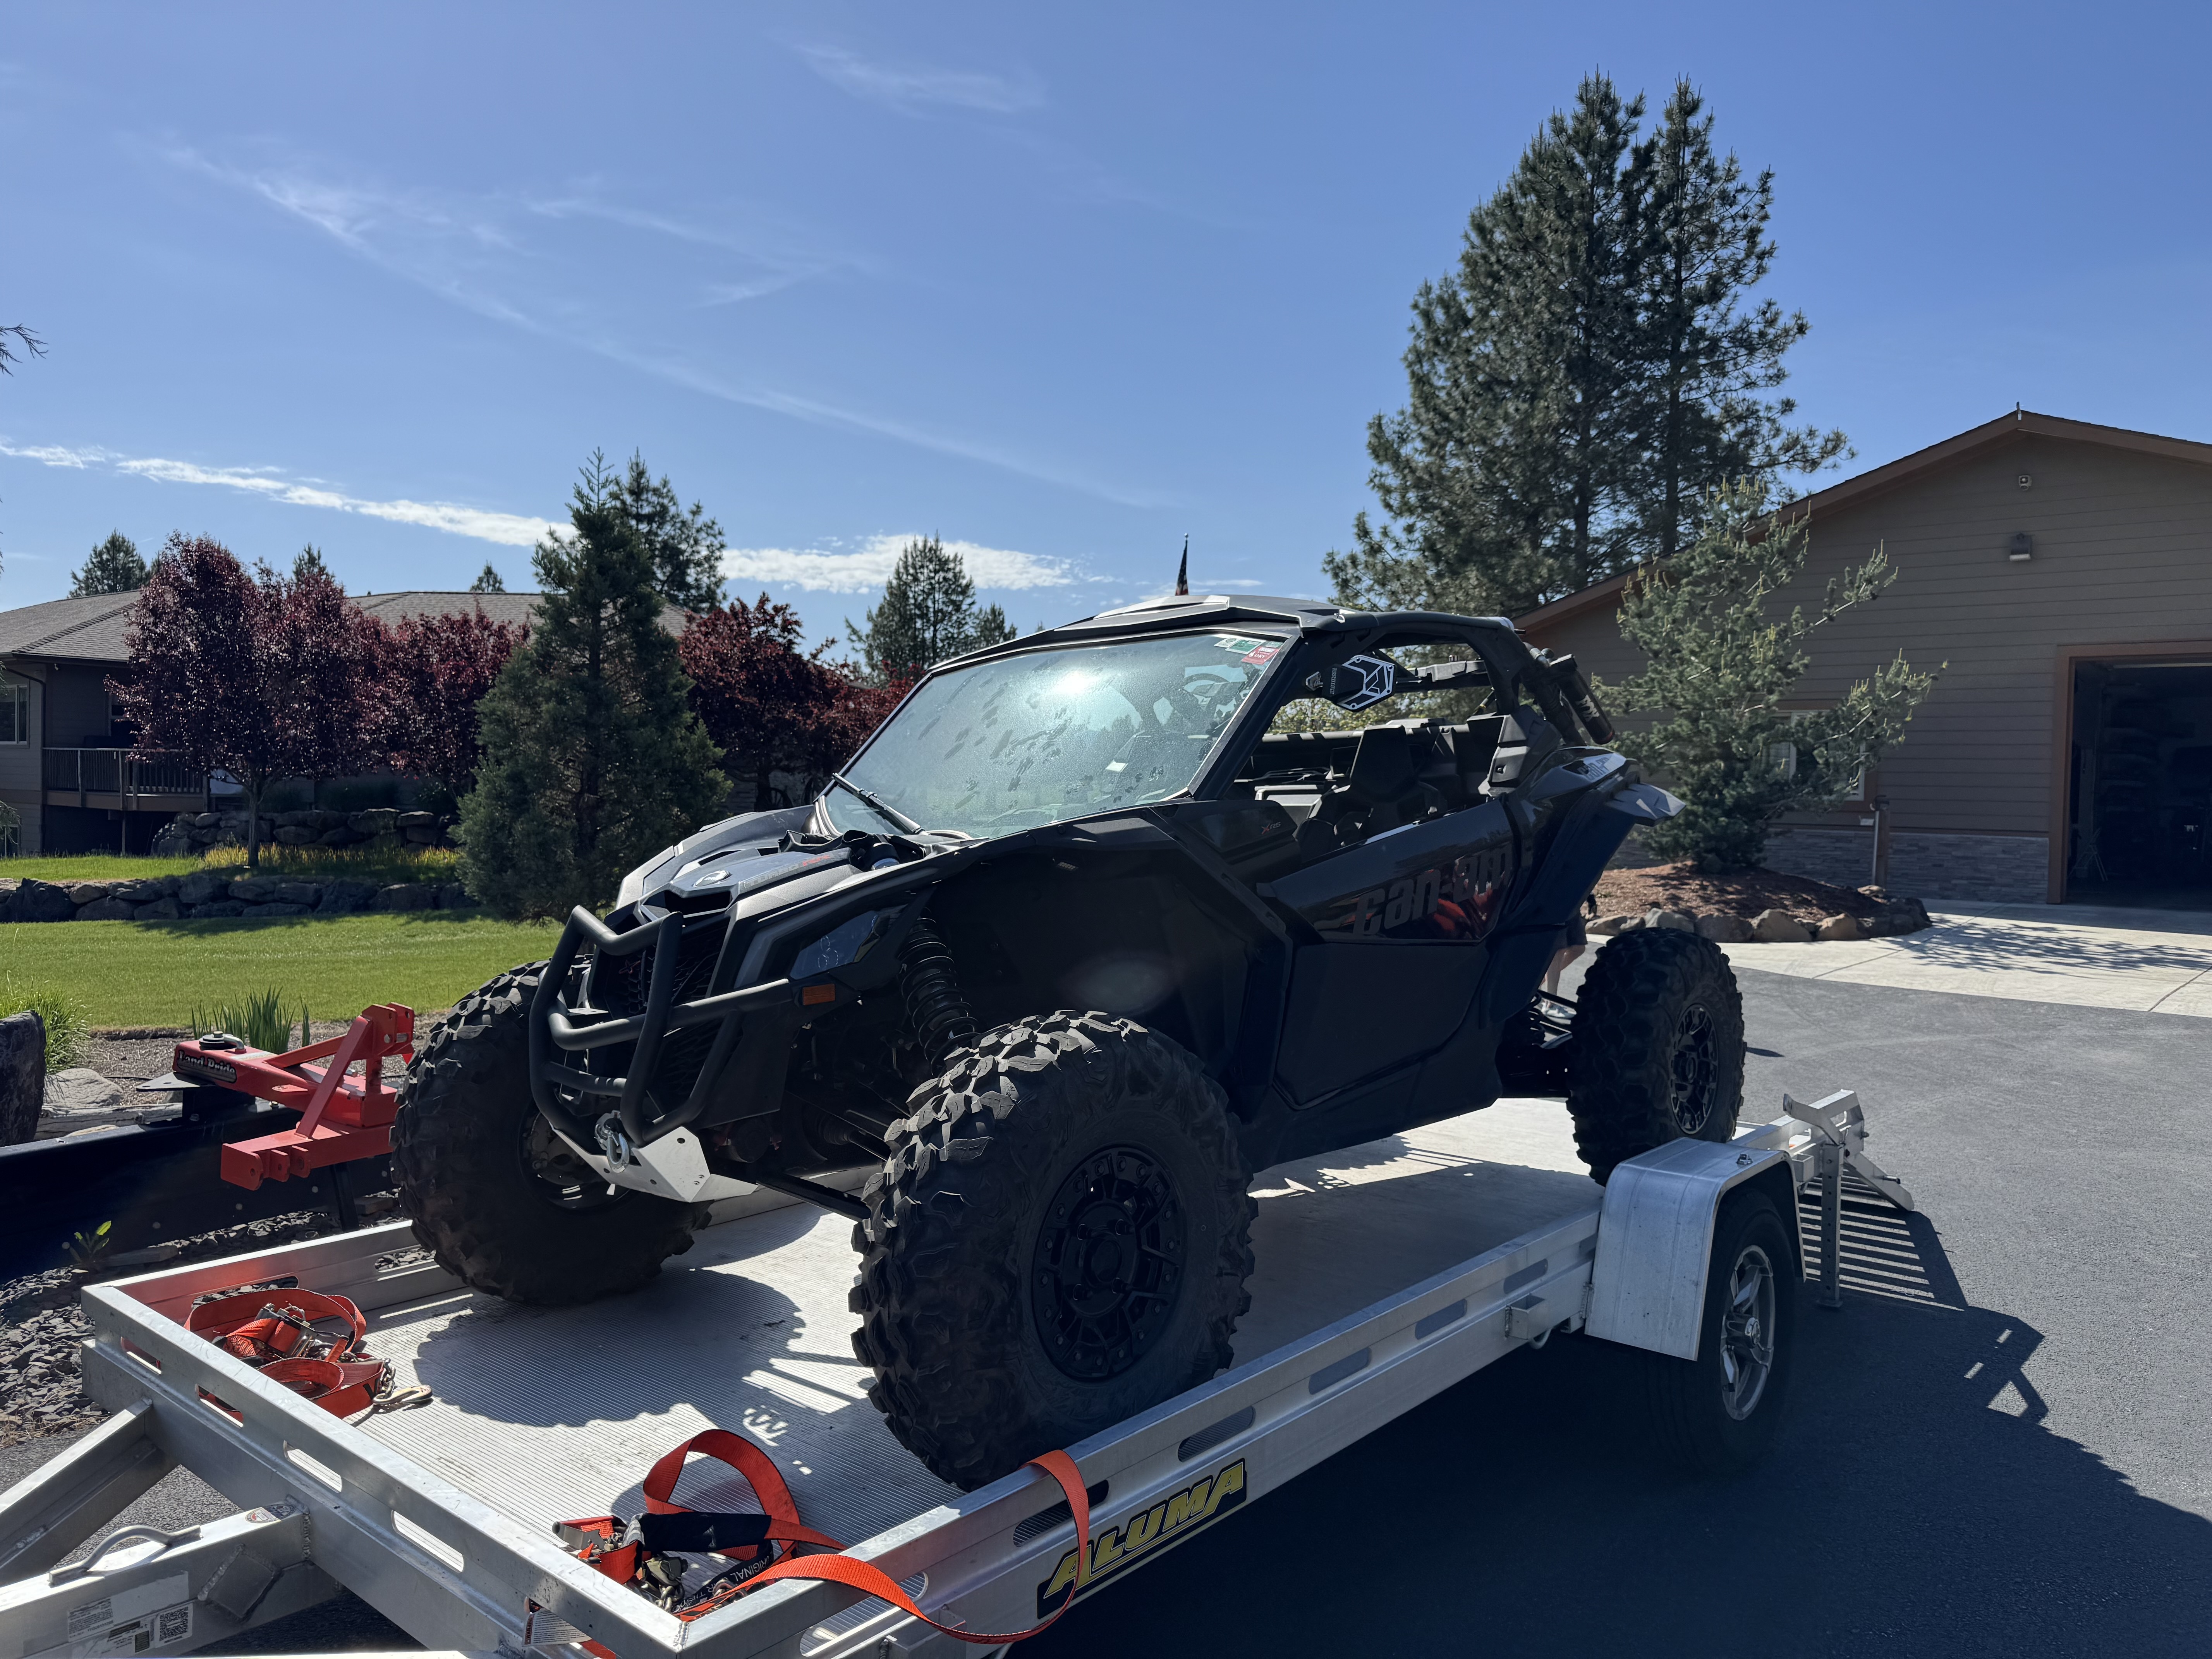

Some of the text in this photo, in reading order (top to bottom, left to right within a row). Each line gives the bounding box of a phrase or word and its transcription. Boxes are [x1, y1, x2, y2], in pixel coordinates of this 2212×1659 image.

[1575, 694, 1600, 722] FOX
[179, 1050, 235, 1073] Land Pride
[1043, 1461, 1243, 1599] ALUMA
